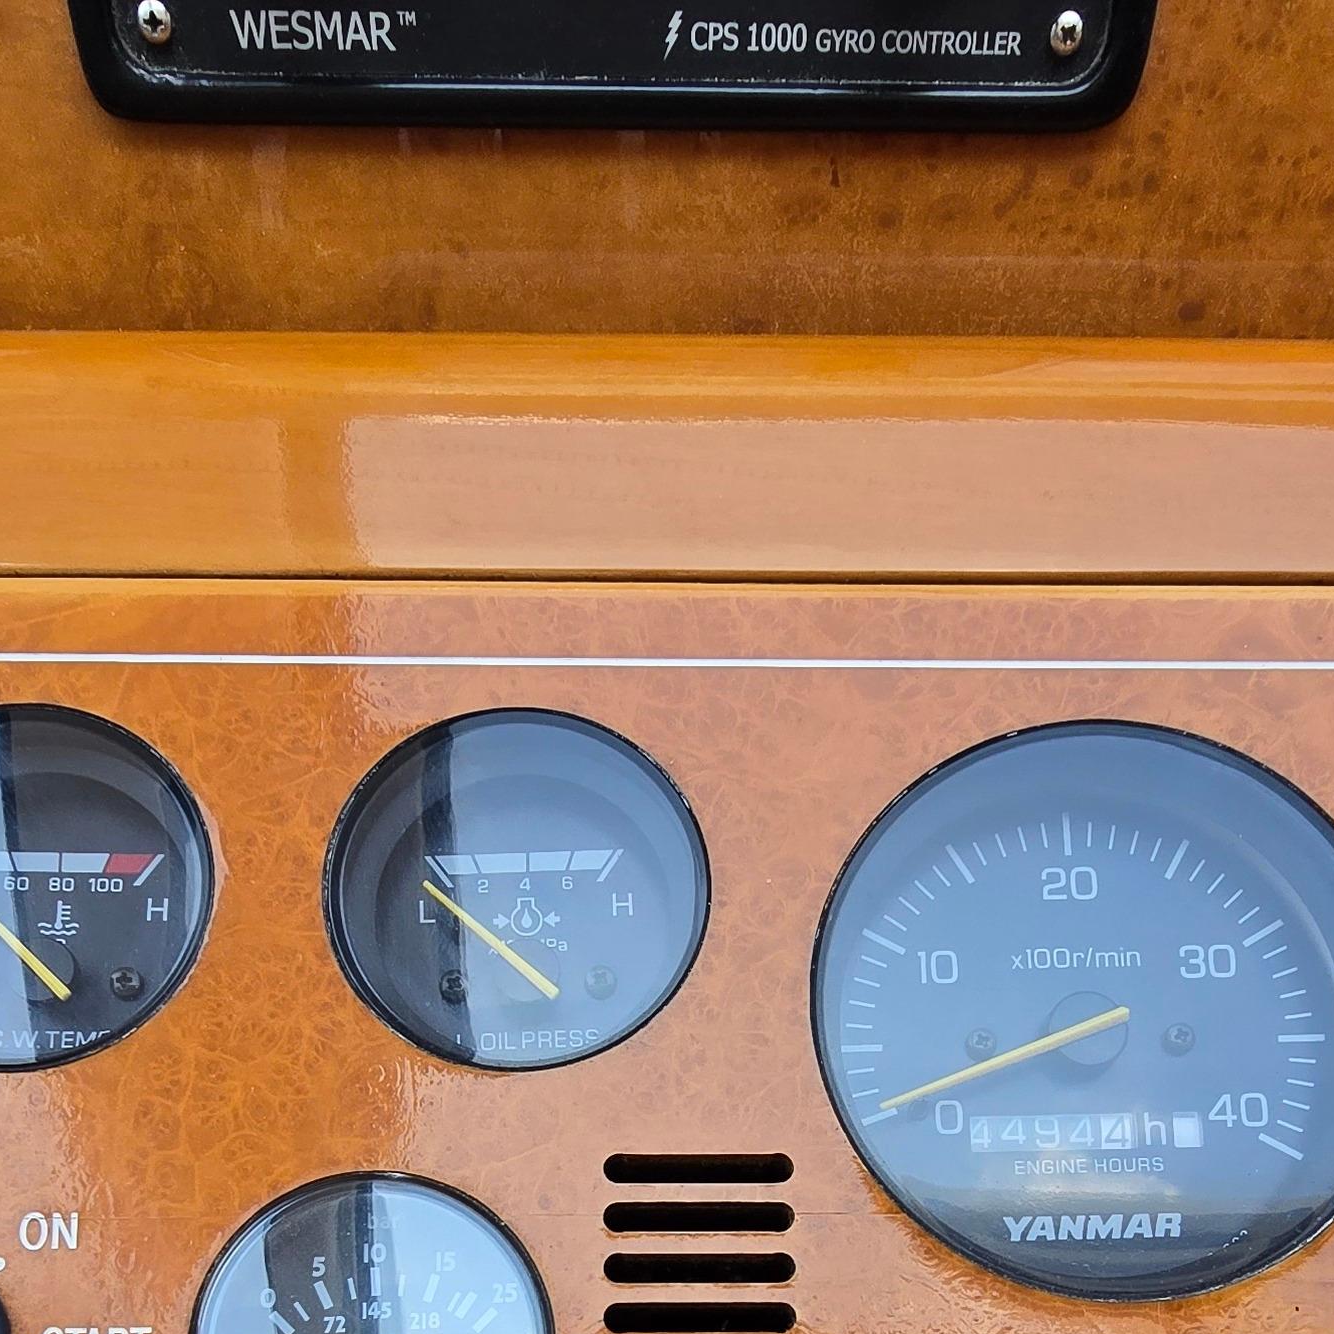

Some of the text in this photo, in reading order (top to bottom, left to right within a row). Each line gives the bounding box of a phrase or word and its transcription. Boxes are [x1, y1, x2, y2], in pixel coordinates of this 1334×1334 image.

[690, 21, 1022, 57] CPS 1000 GYRO CONTROLLER
[3, 876, 123, 893] 60 80 100
[477, 875, 573, 894] 2 4 6
[1041, 866, 1098, 901] 20
[146, 897, 170, 922] H
[418, 899, 437, 925] L
[611, 892, 634, 917] H
[917, 950, 959, 985] 10
[1179, 943, 1236, 979] 30
[934, 1100, 964, 1136] 0
[1208, 1092, 1269, 1128] 40
[1014, 1156, 1165, 1176] ENGINE HOURS
[18, 1211, 79, 1251] ON
[1003, 1212, 1182, 1242] YANMAR
[363, 1243, 387, 1264] 10
[434, 1251, 456, 1272] 15
[312, 1256, 326, 1278] 5
[260, 1288, 277, 1309] 0
[492, 1282, 518, 1304] 25
[361, 1302, 392, 1320] 145
[410, 1312, 440, 1331] 218
[323, 1316, 346, 1334] 72
